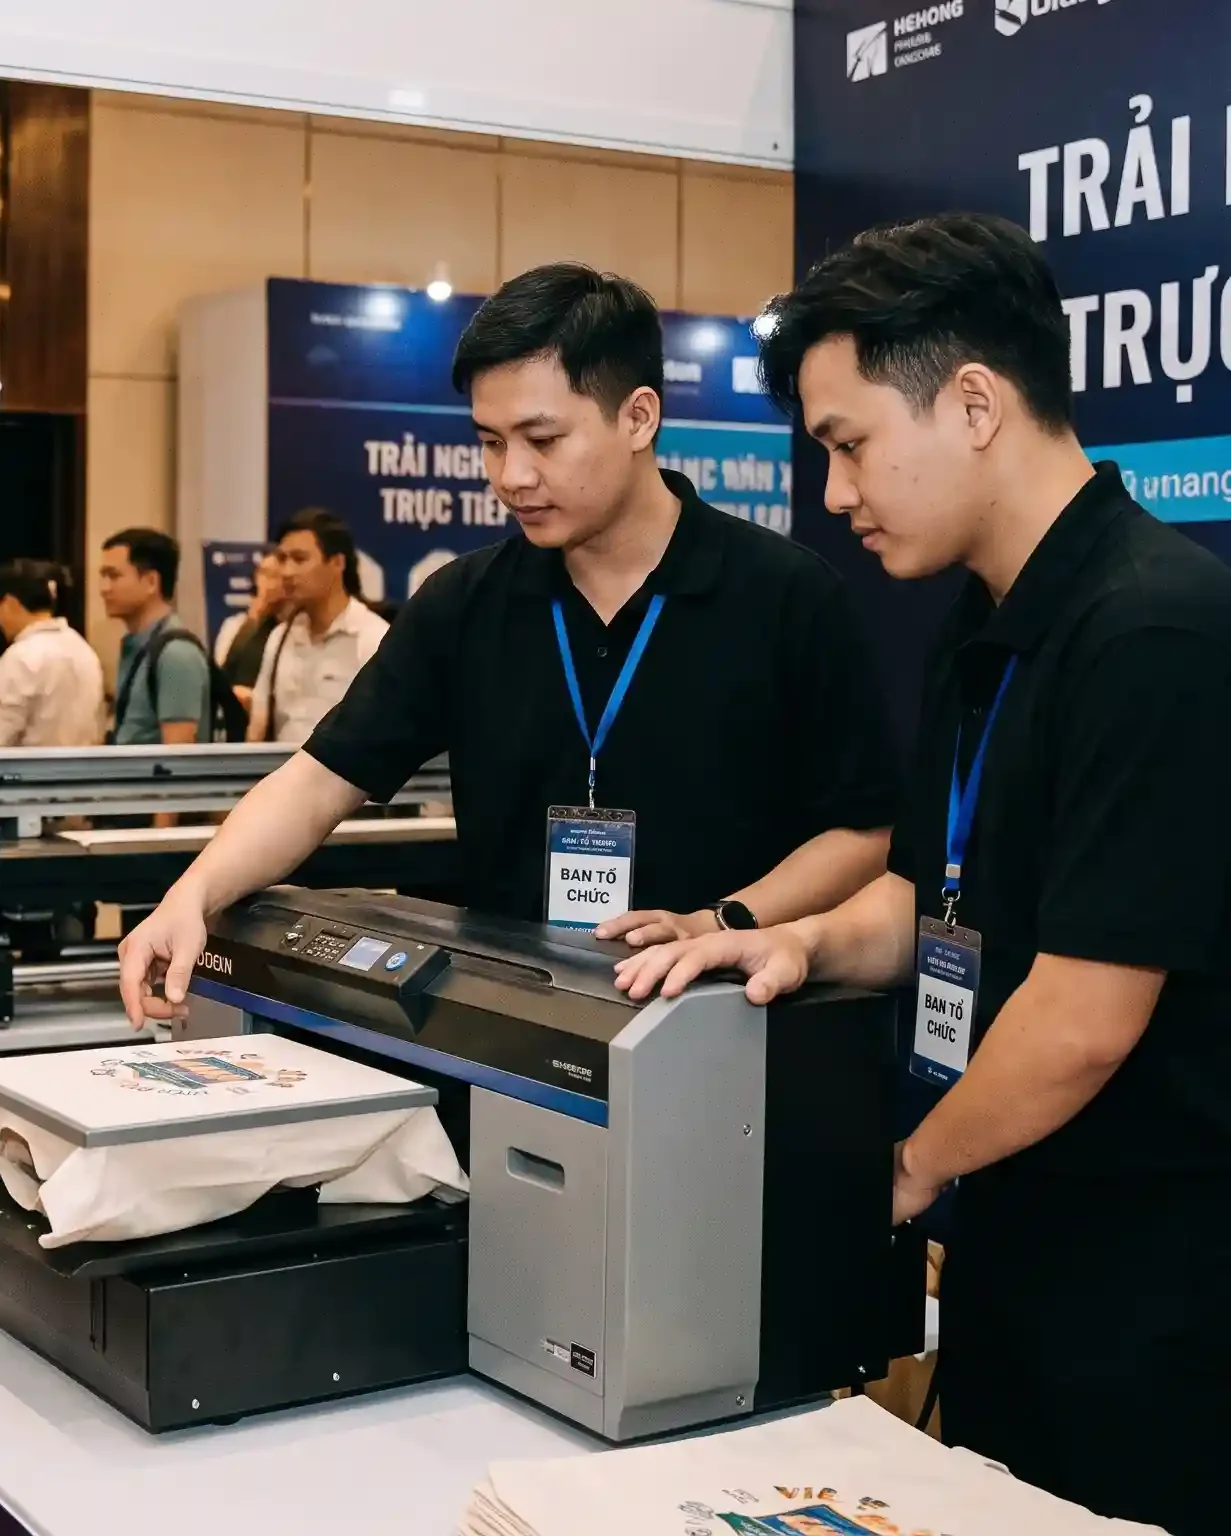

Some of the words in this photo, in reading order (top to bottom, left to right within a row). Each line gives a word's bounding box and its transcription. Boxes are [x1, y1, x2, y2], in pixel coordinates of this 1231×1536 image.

[1018, 94, 1190, 243] TRẢI
[364, 432, 427, 477] TRẢI
[380, 487, 453, 531] TRỰC
[561, 868, 592, 882] BAN
[567, 888, 610, 904] CHỨC
[925, 993, 946, 1015] BAN
[949, 998, 963, 1021] TỔ
[927, 1019, 956, 1043] CHỨC
